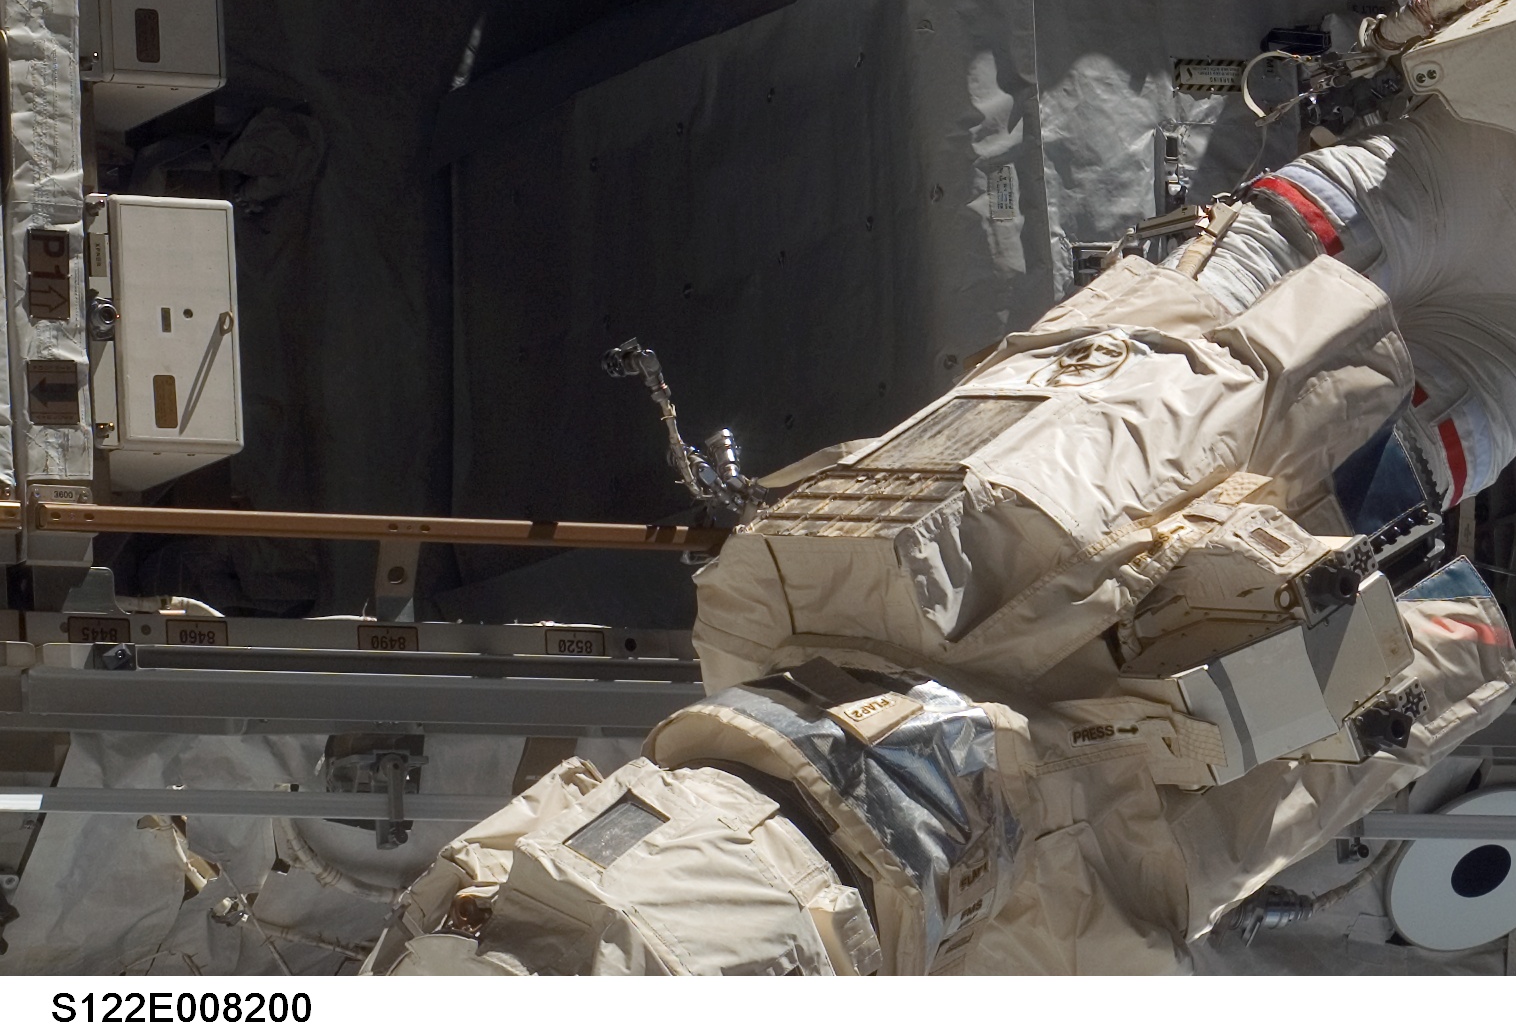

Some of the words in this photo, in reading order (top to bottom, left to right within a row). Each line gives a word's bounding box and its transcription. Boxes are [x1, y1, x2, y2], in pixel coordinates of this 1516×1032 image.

[32, 234, 66, 280] P1
[53, 490, 74, 500] 3600
[81, 625, 118, 641] 8445
[179, 629, 216, 645] 8460
[371, 635, 407, 651] 8490
[558, 639, 593, 655] 8520
[852, 699, 890, 718] FLAP2
[1072, 725, 1115, 745] PRESS
